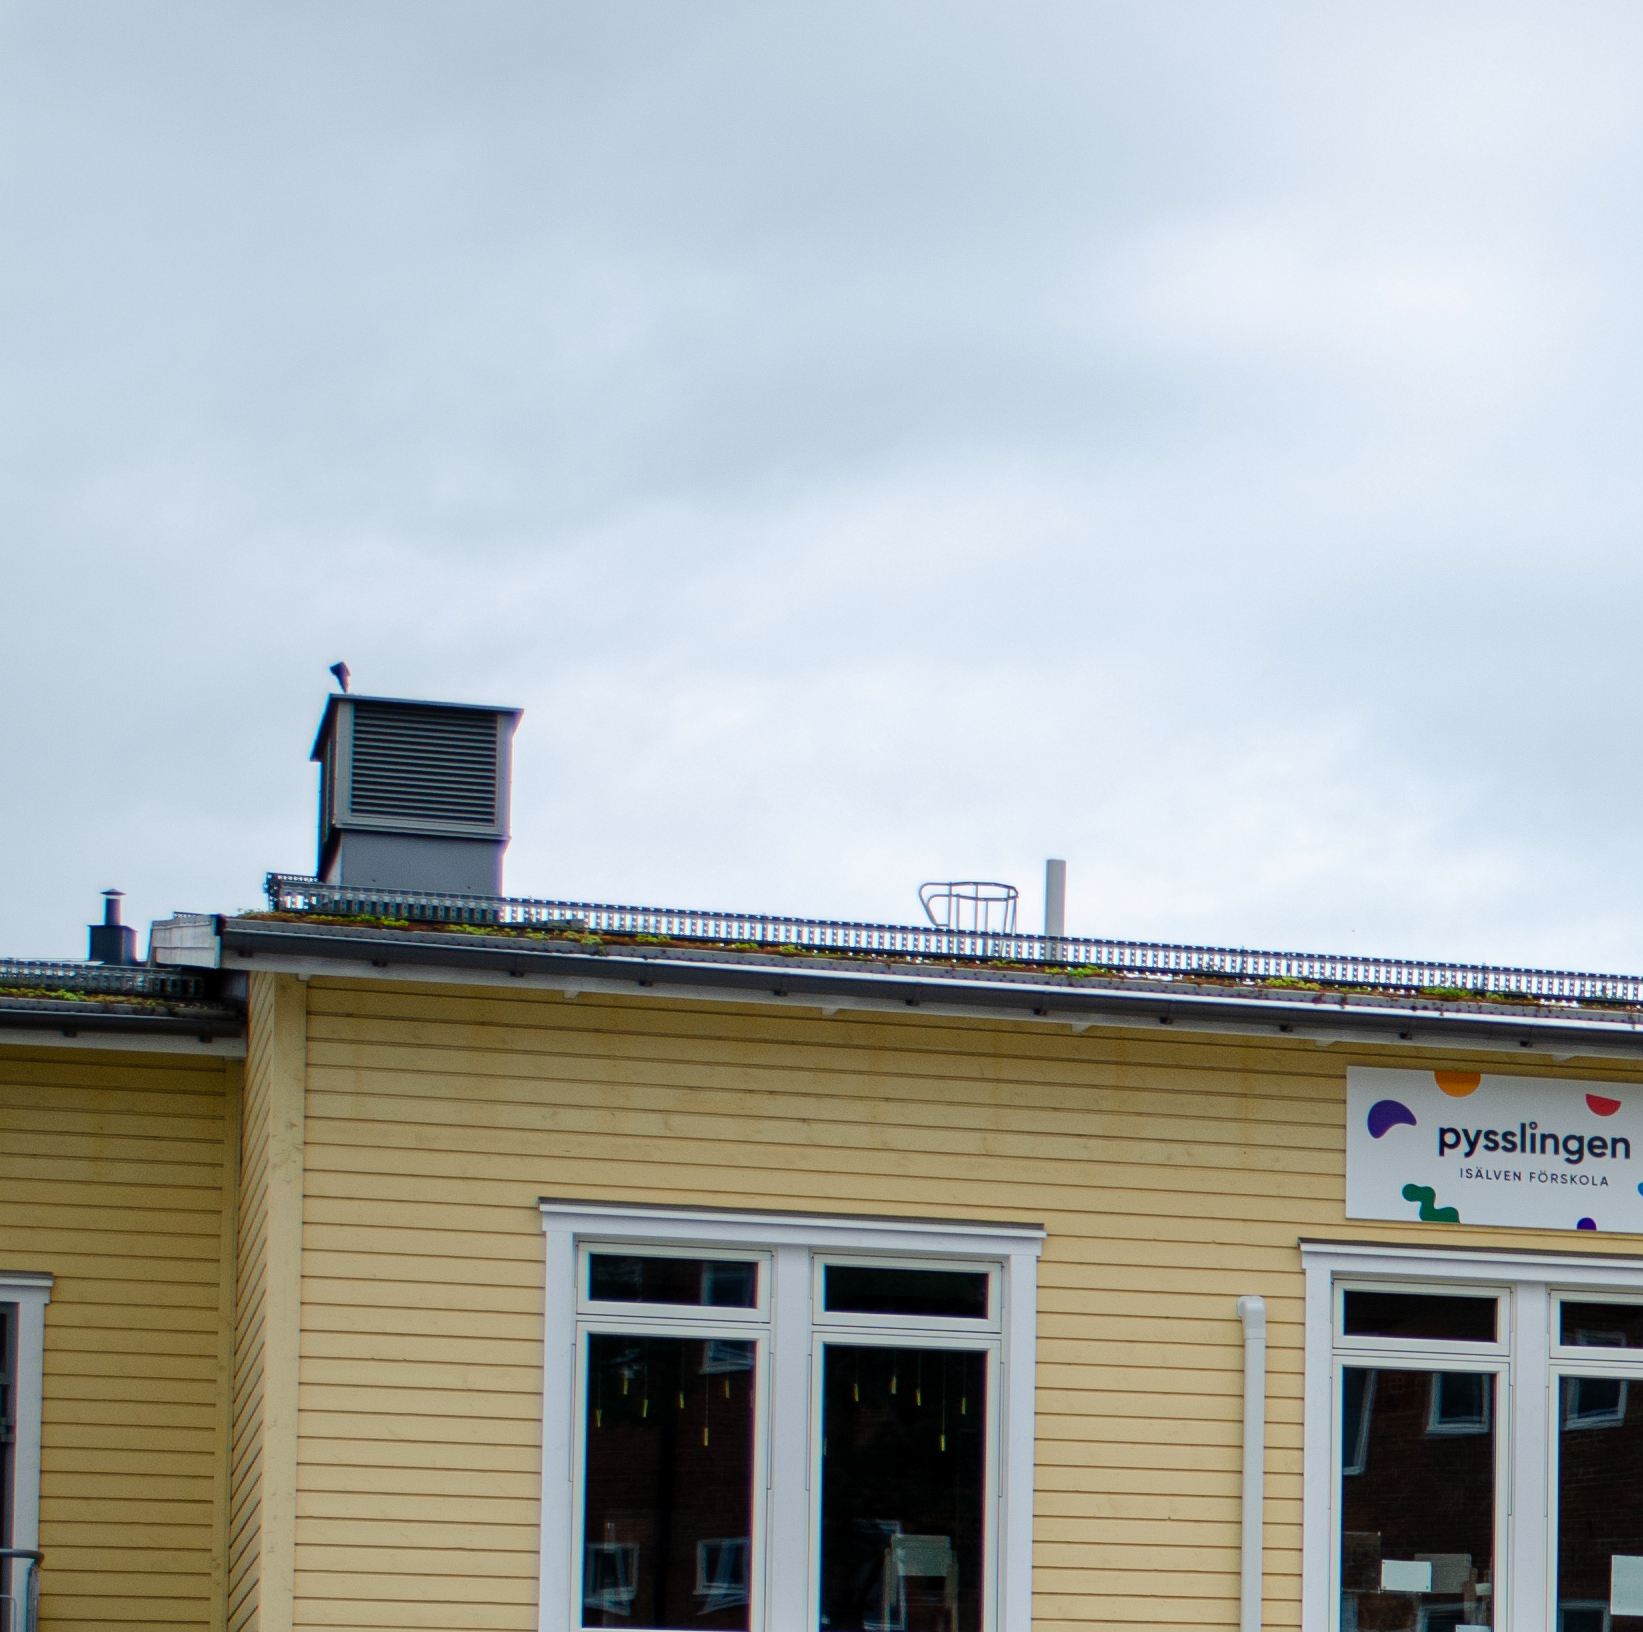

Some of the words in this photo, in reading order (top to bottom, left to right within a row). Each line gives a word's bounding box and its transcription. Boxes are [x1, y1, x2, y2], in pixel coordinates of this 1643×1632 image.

[1438, 1121, 1631, 1165] pysslingen
[1459, 1167, 1522, 1182] ISÄLVEN
[1529, 1171, 1609, 1187] FÖRSKOLA
